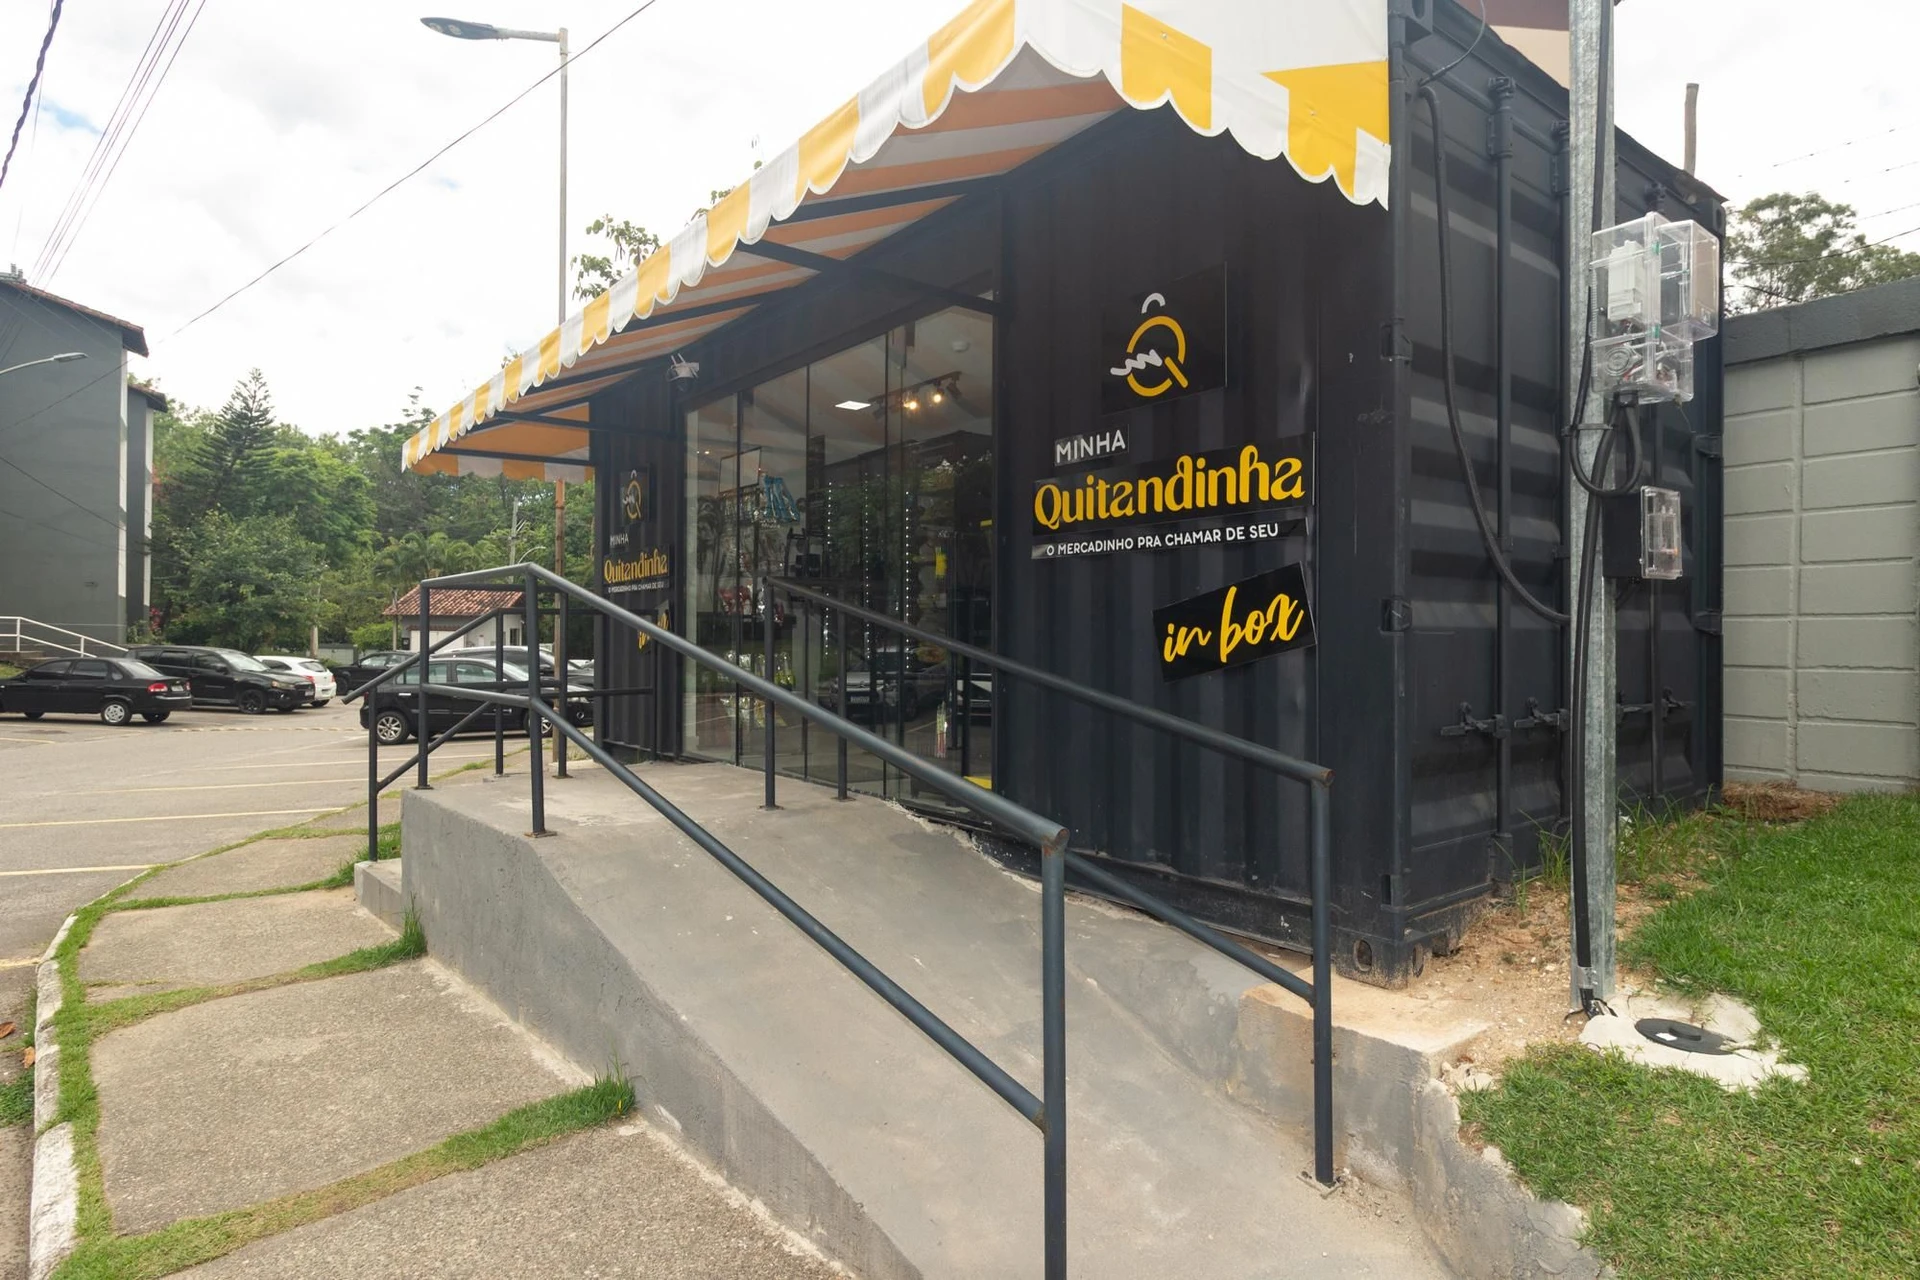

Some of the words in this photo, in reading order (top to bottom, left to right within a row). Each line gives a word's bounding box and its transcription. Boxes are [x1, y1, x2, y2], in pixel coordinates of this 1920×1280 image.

[1056, 429, 1125, 463] MINHA
[1034, 445, 1305, 530] Quitandinha
[609, 533, 629, 546] MINHA
[1046, 545, 1055, 556] O
[1057, 537, 1134, 555] MERCADINHO
[1137, 535, 1162, 549] PRA
[1165, 530, 1221, 546] CHAMAR
[1225, 526, 1246, 541] DE
[1249, 523, 1279, 538] SEU
[604, 549, 668, 583] Quitandinha
[1163, 622, 1212, 662] in
[1219, 586, 1304, 662] box
